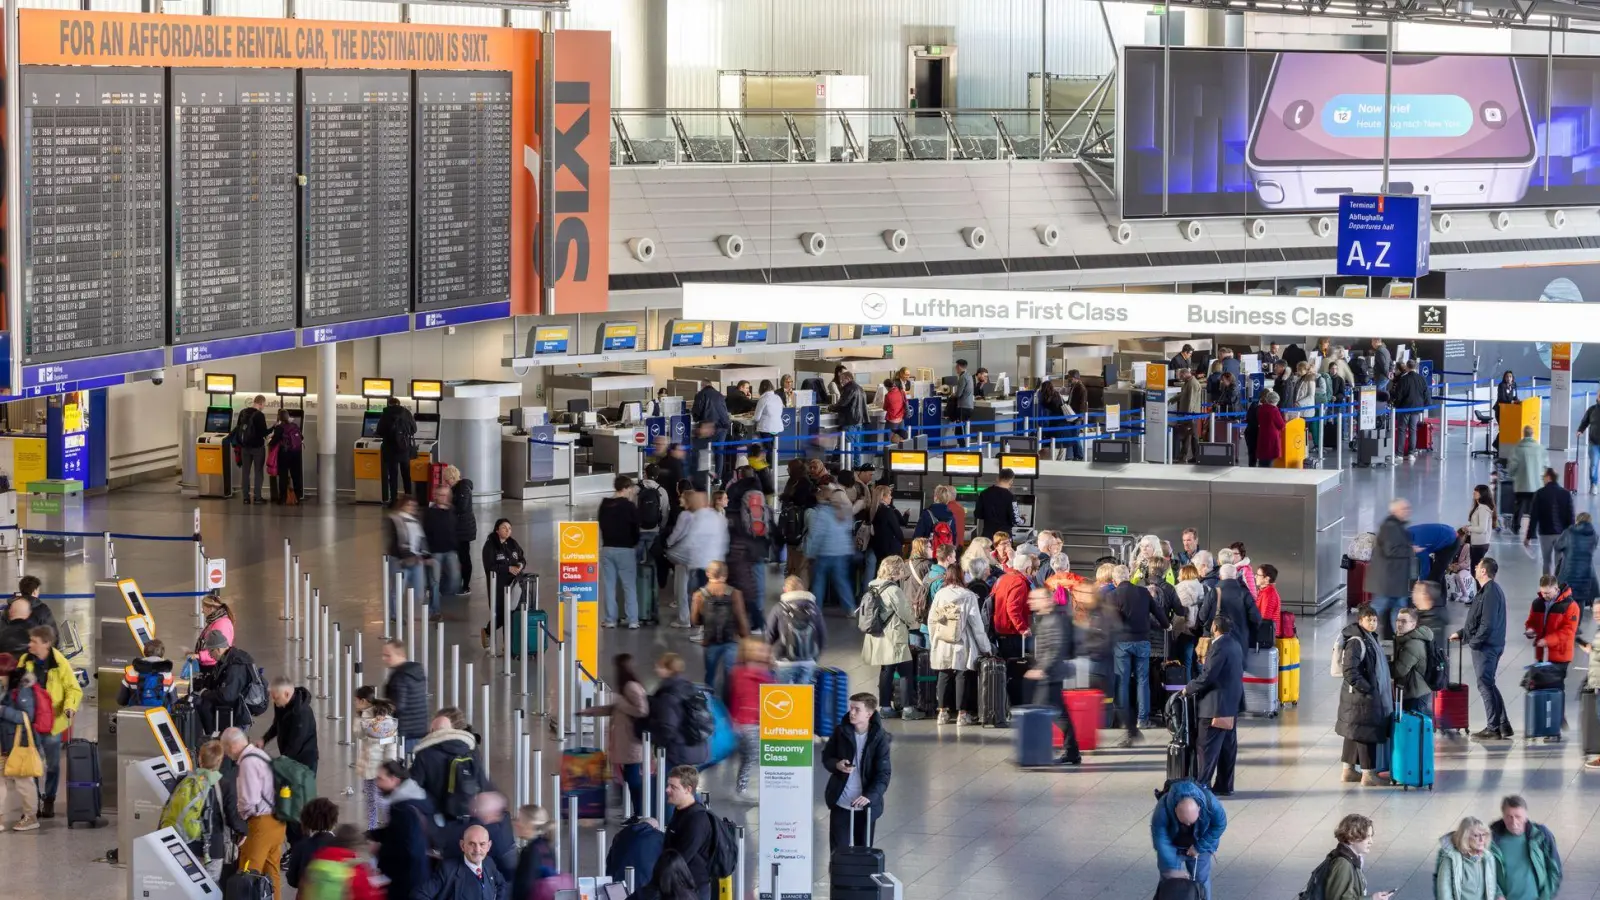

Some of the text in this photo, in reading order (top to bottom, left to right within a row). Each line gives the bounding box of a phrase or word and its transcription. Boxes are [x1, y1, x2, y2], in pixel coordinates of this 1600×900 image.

[60, 19, 490, 65] FOR AN AFFORDABLE RENTAL CAR, THE DESTINATION IS SIXT.
[1358, 103, 1383, 114] Now
[1338, 113, 1348, 121] 12
[1356, 119, 1382, 128] Heute
[1350, 201, 1375, 209] Terminal
[1349, 213, 1384, 222] Abflughalle
[1348, 222, 1395, 231] Departures hall
[1346, 240, 1391, 270] A,Z
[902, 297, 1128, 322] Lufthansa First Class
[1188, 304, 1354, 327] Business Class
[563, 572, 582, 580] Class
[764, 726, 809, 736] Lufthansa
[764, 744, 804, 754] Economy
[764, 753, 788, 762] Class
